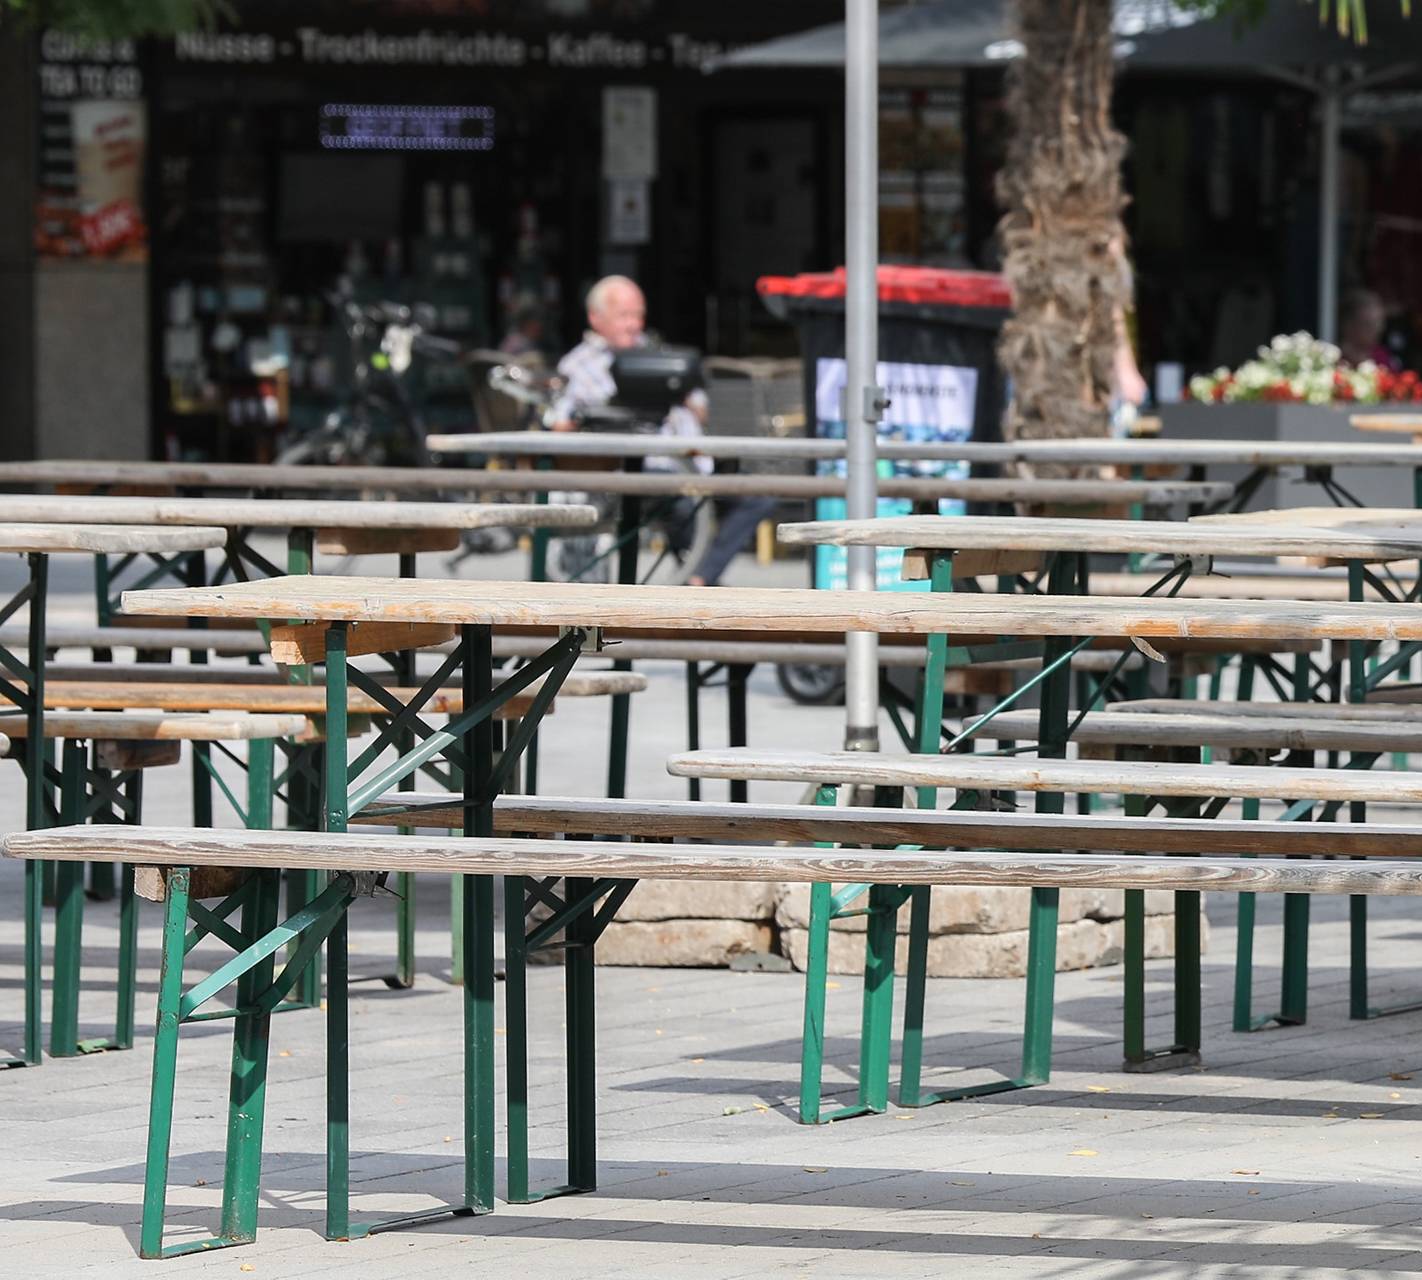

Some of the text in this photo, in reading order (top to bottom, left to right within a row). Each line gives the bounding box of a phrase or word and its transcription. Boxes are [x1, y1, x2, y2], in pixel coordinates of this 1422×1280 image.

[296, 27, 526, 66] Trockenfrüchte
[547, 31, 646, 68] Kaffee
[39, 65, 77, 96] TEA
[79, 65, 106, 96] TO
